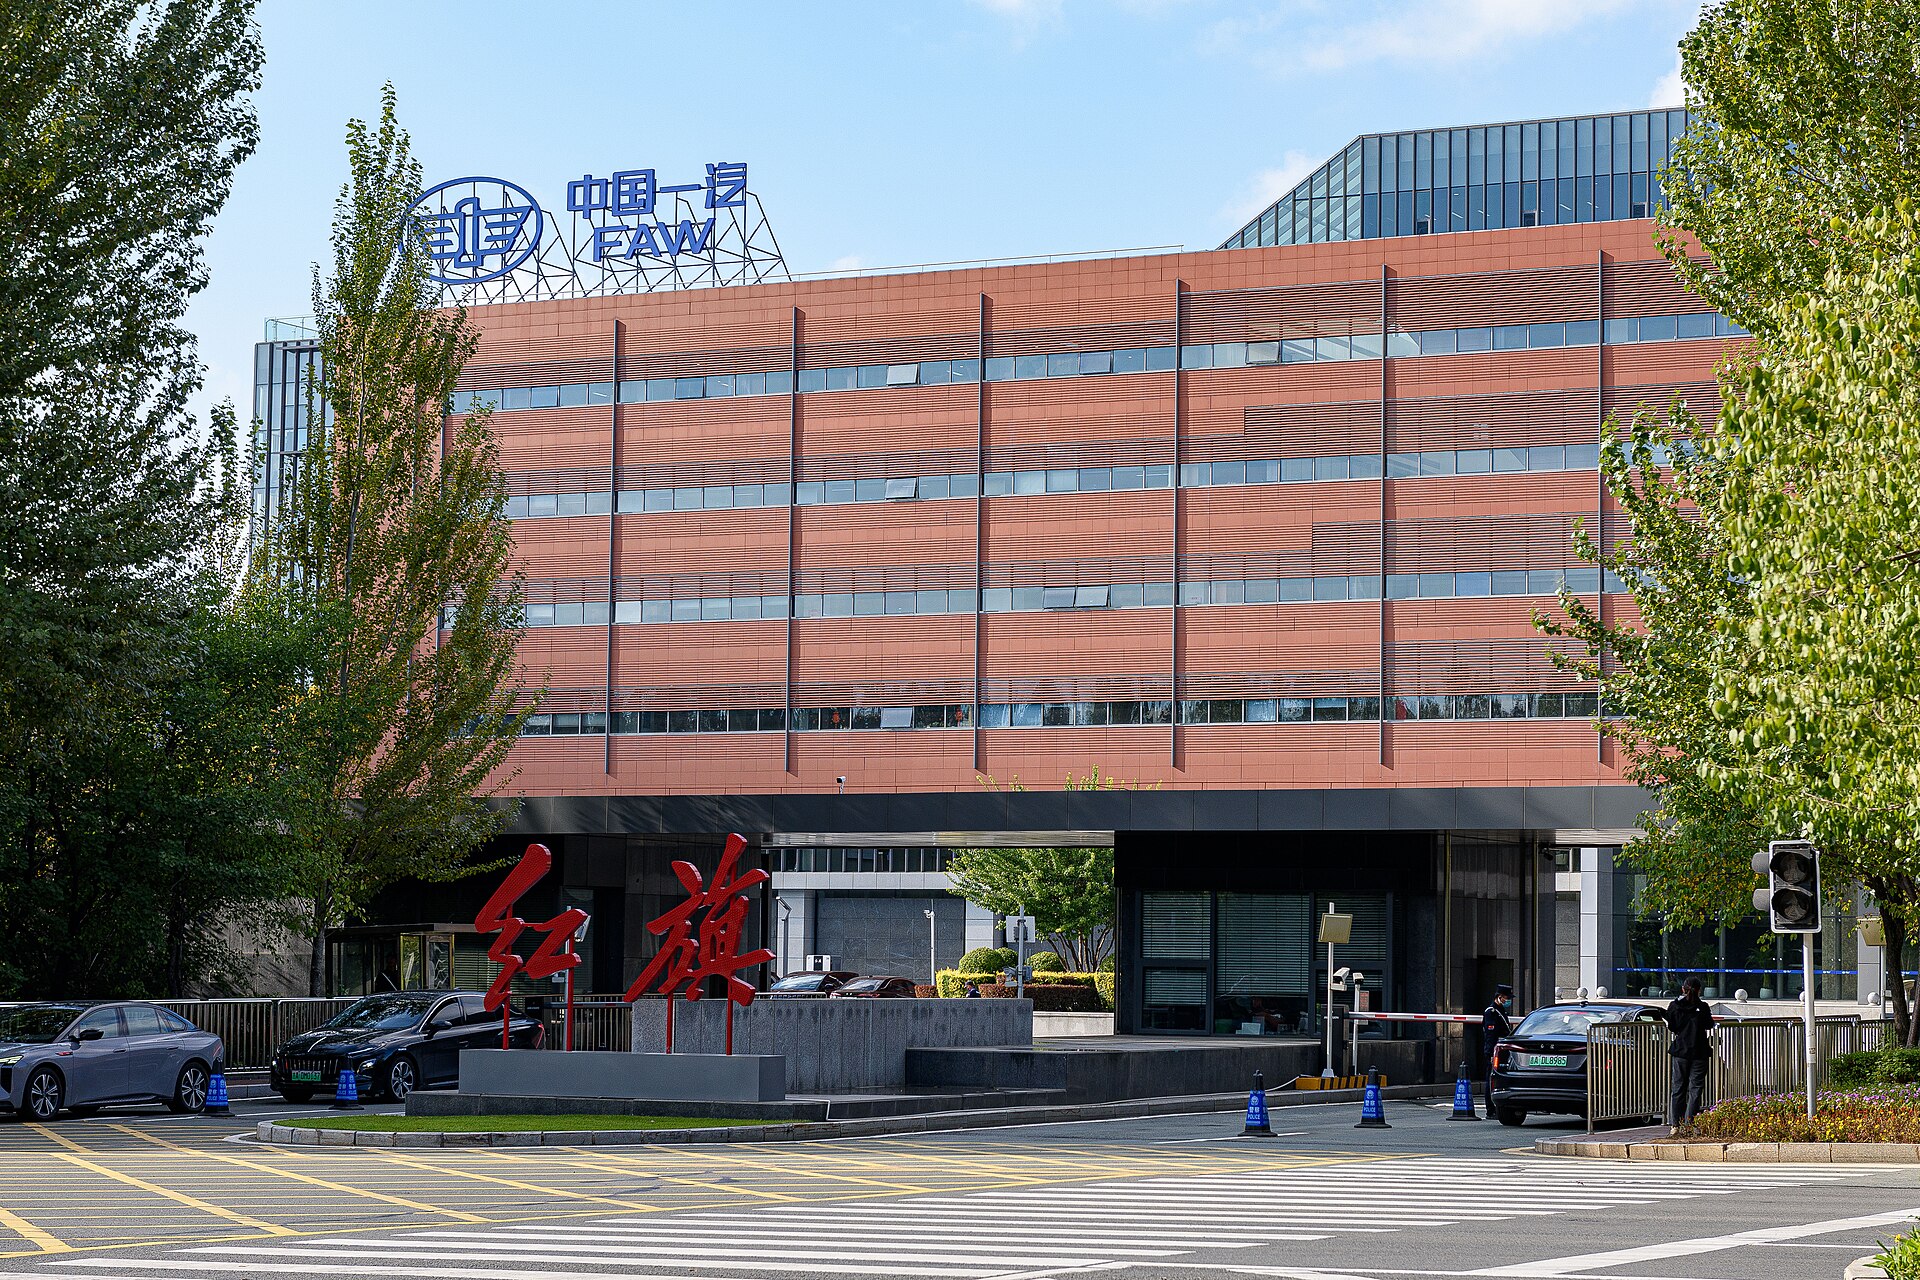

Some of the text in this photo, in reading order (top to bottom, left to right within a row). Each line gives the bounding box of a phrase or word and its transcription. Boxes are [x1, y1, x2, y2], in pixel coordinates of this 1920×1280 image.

[567, 162, 748, 219] 中国一汽
[593, 218, 716, 262] FAW
[475, 833, 776, 1013] 红旗
